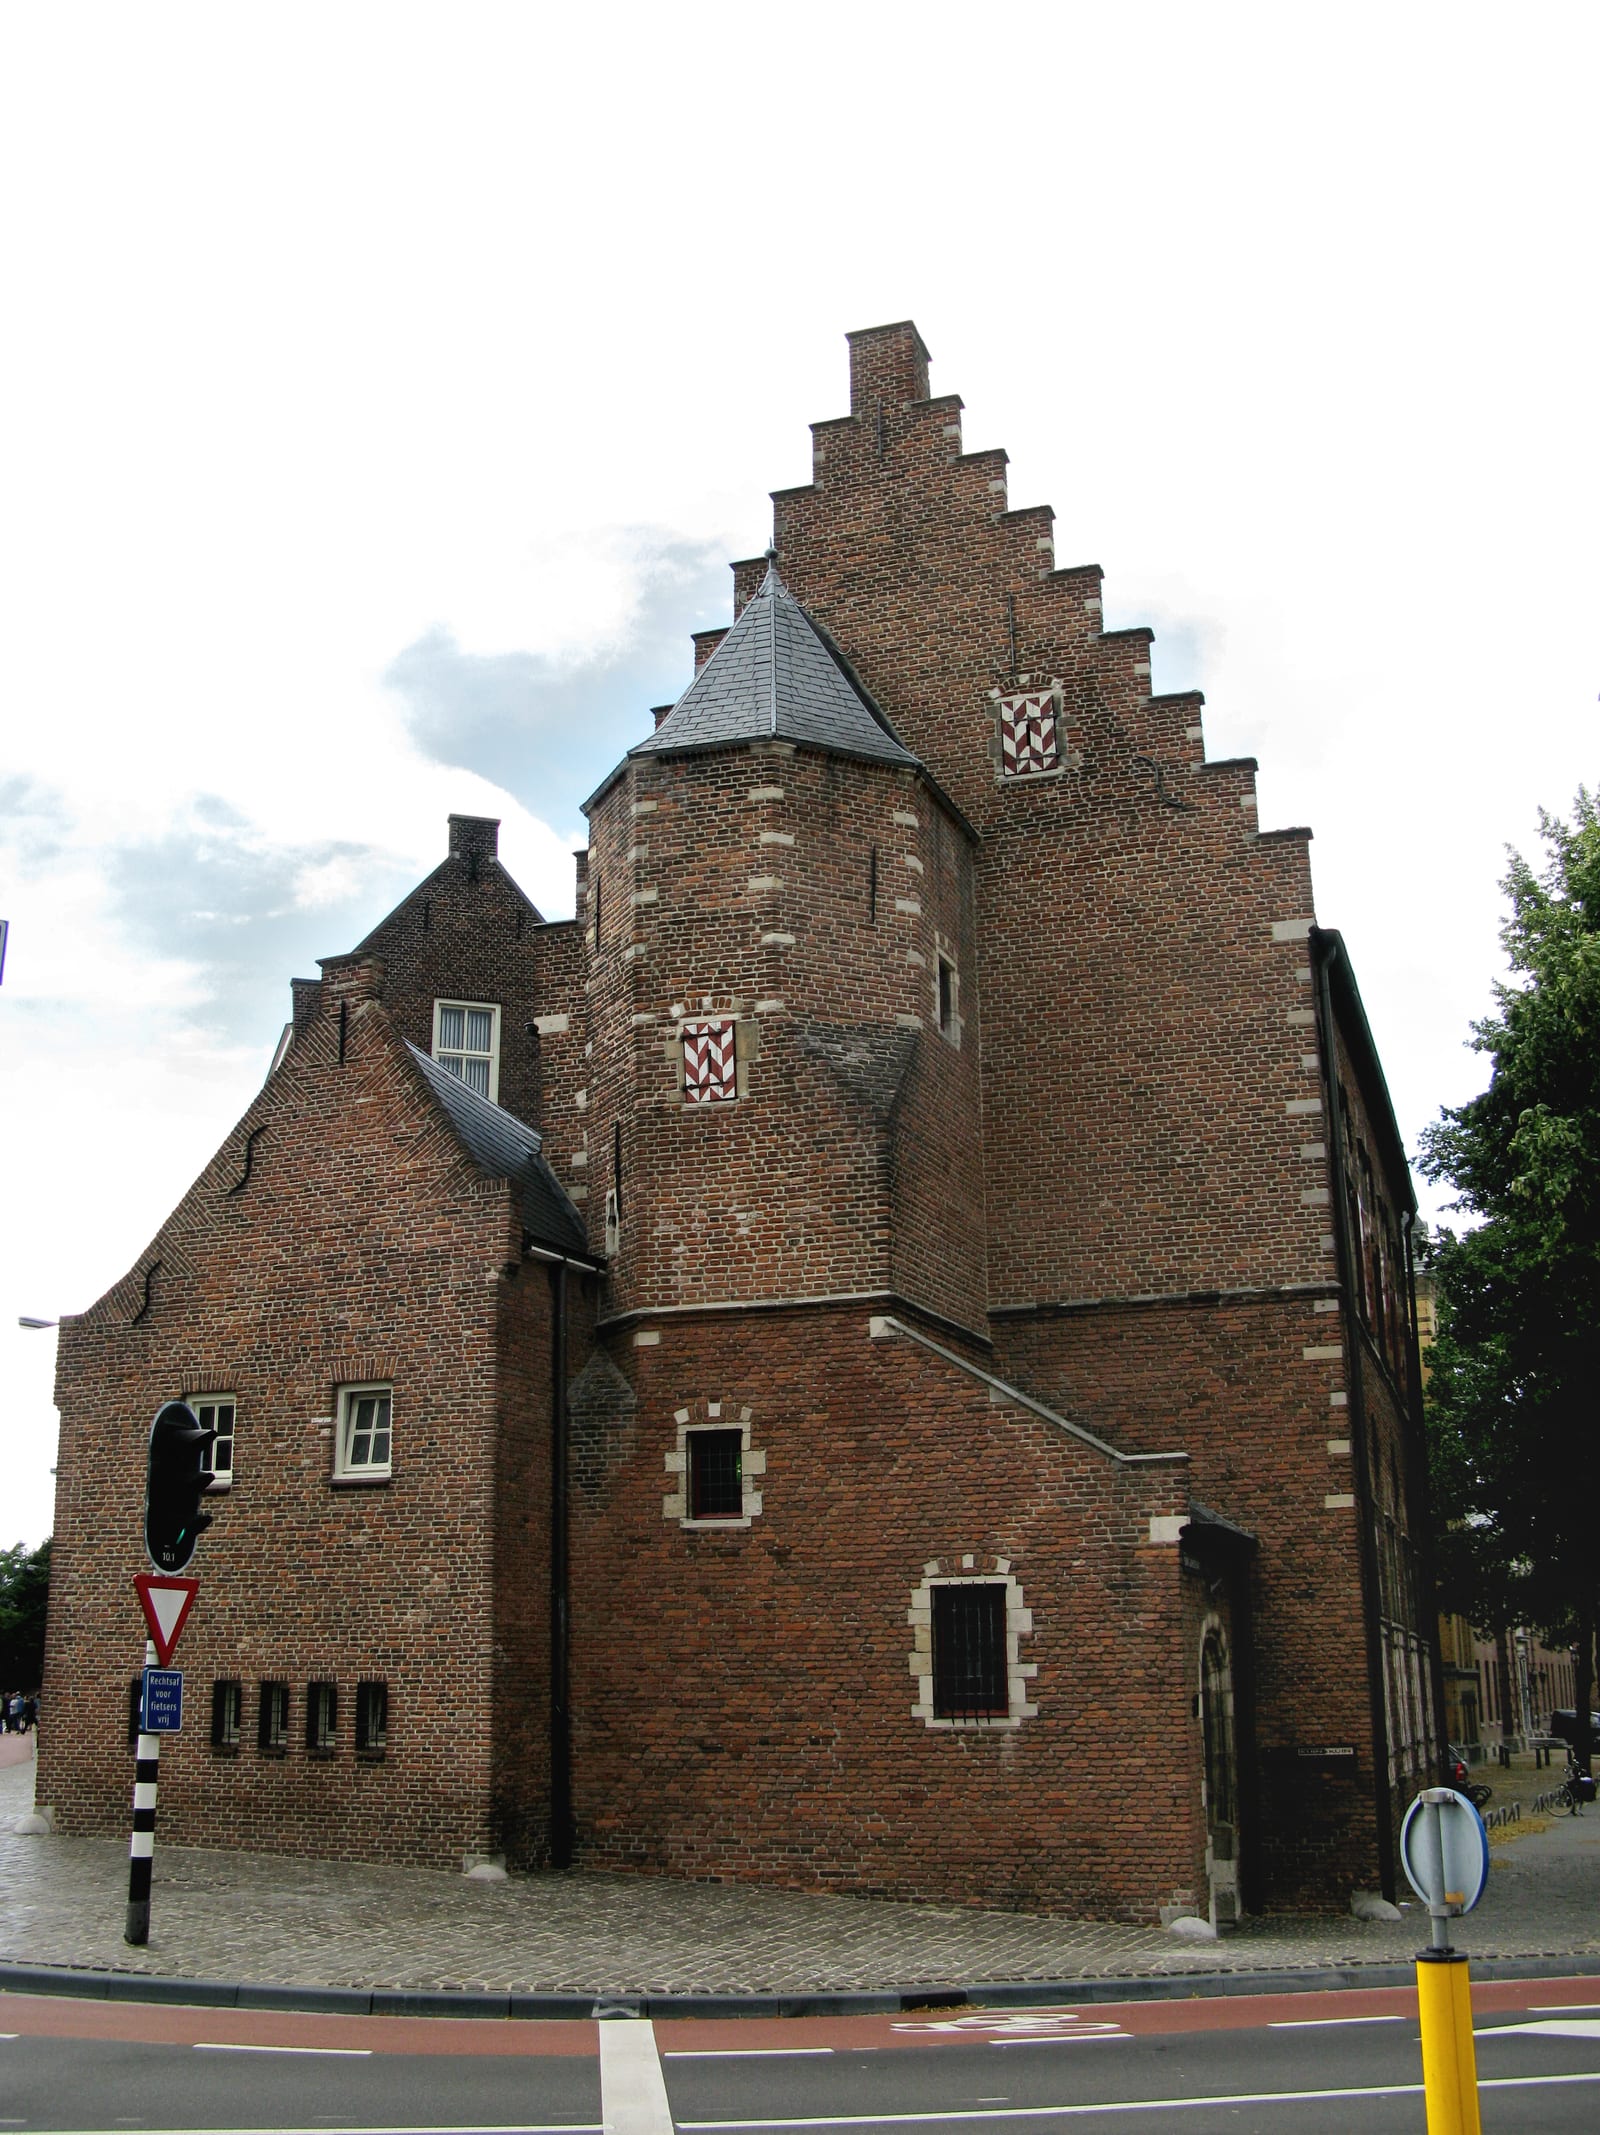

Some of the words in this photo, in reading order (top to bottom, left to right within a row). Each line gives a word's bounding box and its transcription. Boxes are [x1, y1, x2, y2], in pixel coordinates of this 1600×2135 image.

[150, 1675, 180, 1686] Rechtsaf
[155, 1690, 171, 1698] voor
[151, 1701, 177, 1711] fietsers
[157, 1714, 170, 1726] vrij
